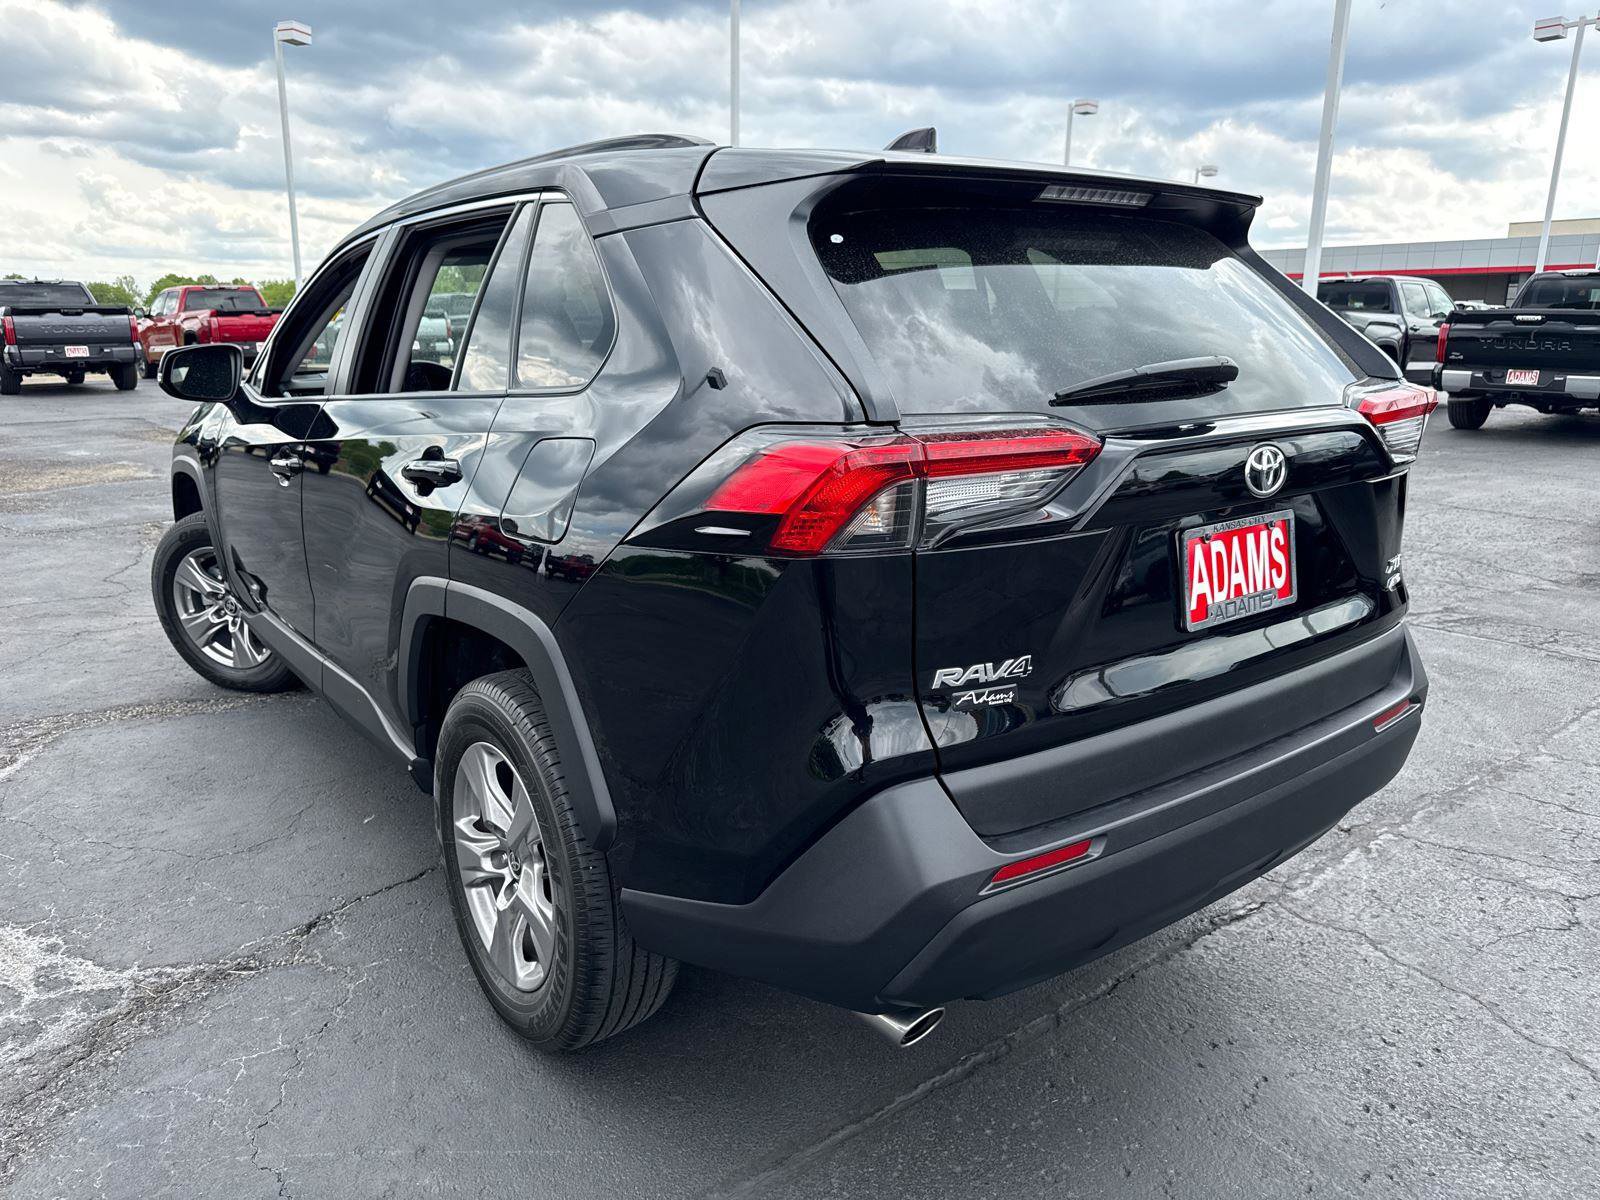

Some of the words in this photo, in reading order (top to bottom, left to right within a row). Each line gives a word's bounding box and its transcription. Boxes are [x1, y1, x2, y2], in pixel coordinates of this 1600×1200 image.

[41, 325, 108, 333] TUNDRA
[1480, 338, 1571, 350] TUNDRA
[1509, 371, 1536, 383] ADAMS
[1213, 520, 1247, 532] KANSAS
[1248, 516, 1266, 526] CITY
[1190, 527, 1287, 611] ADAMS
[931, 655, 1032, 689] RAV4
[956, 690, 1014, 705] Adams
